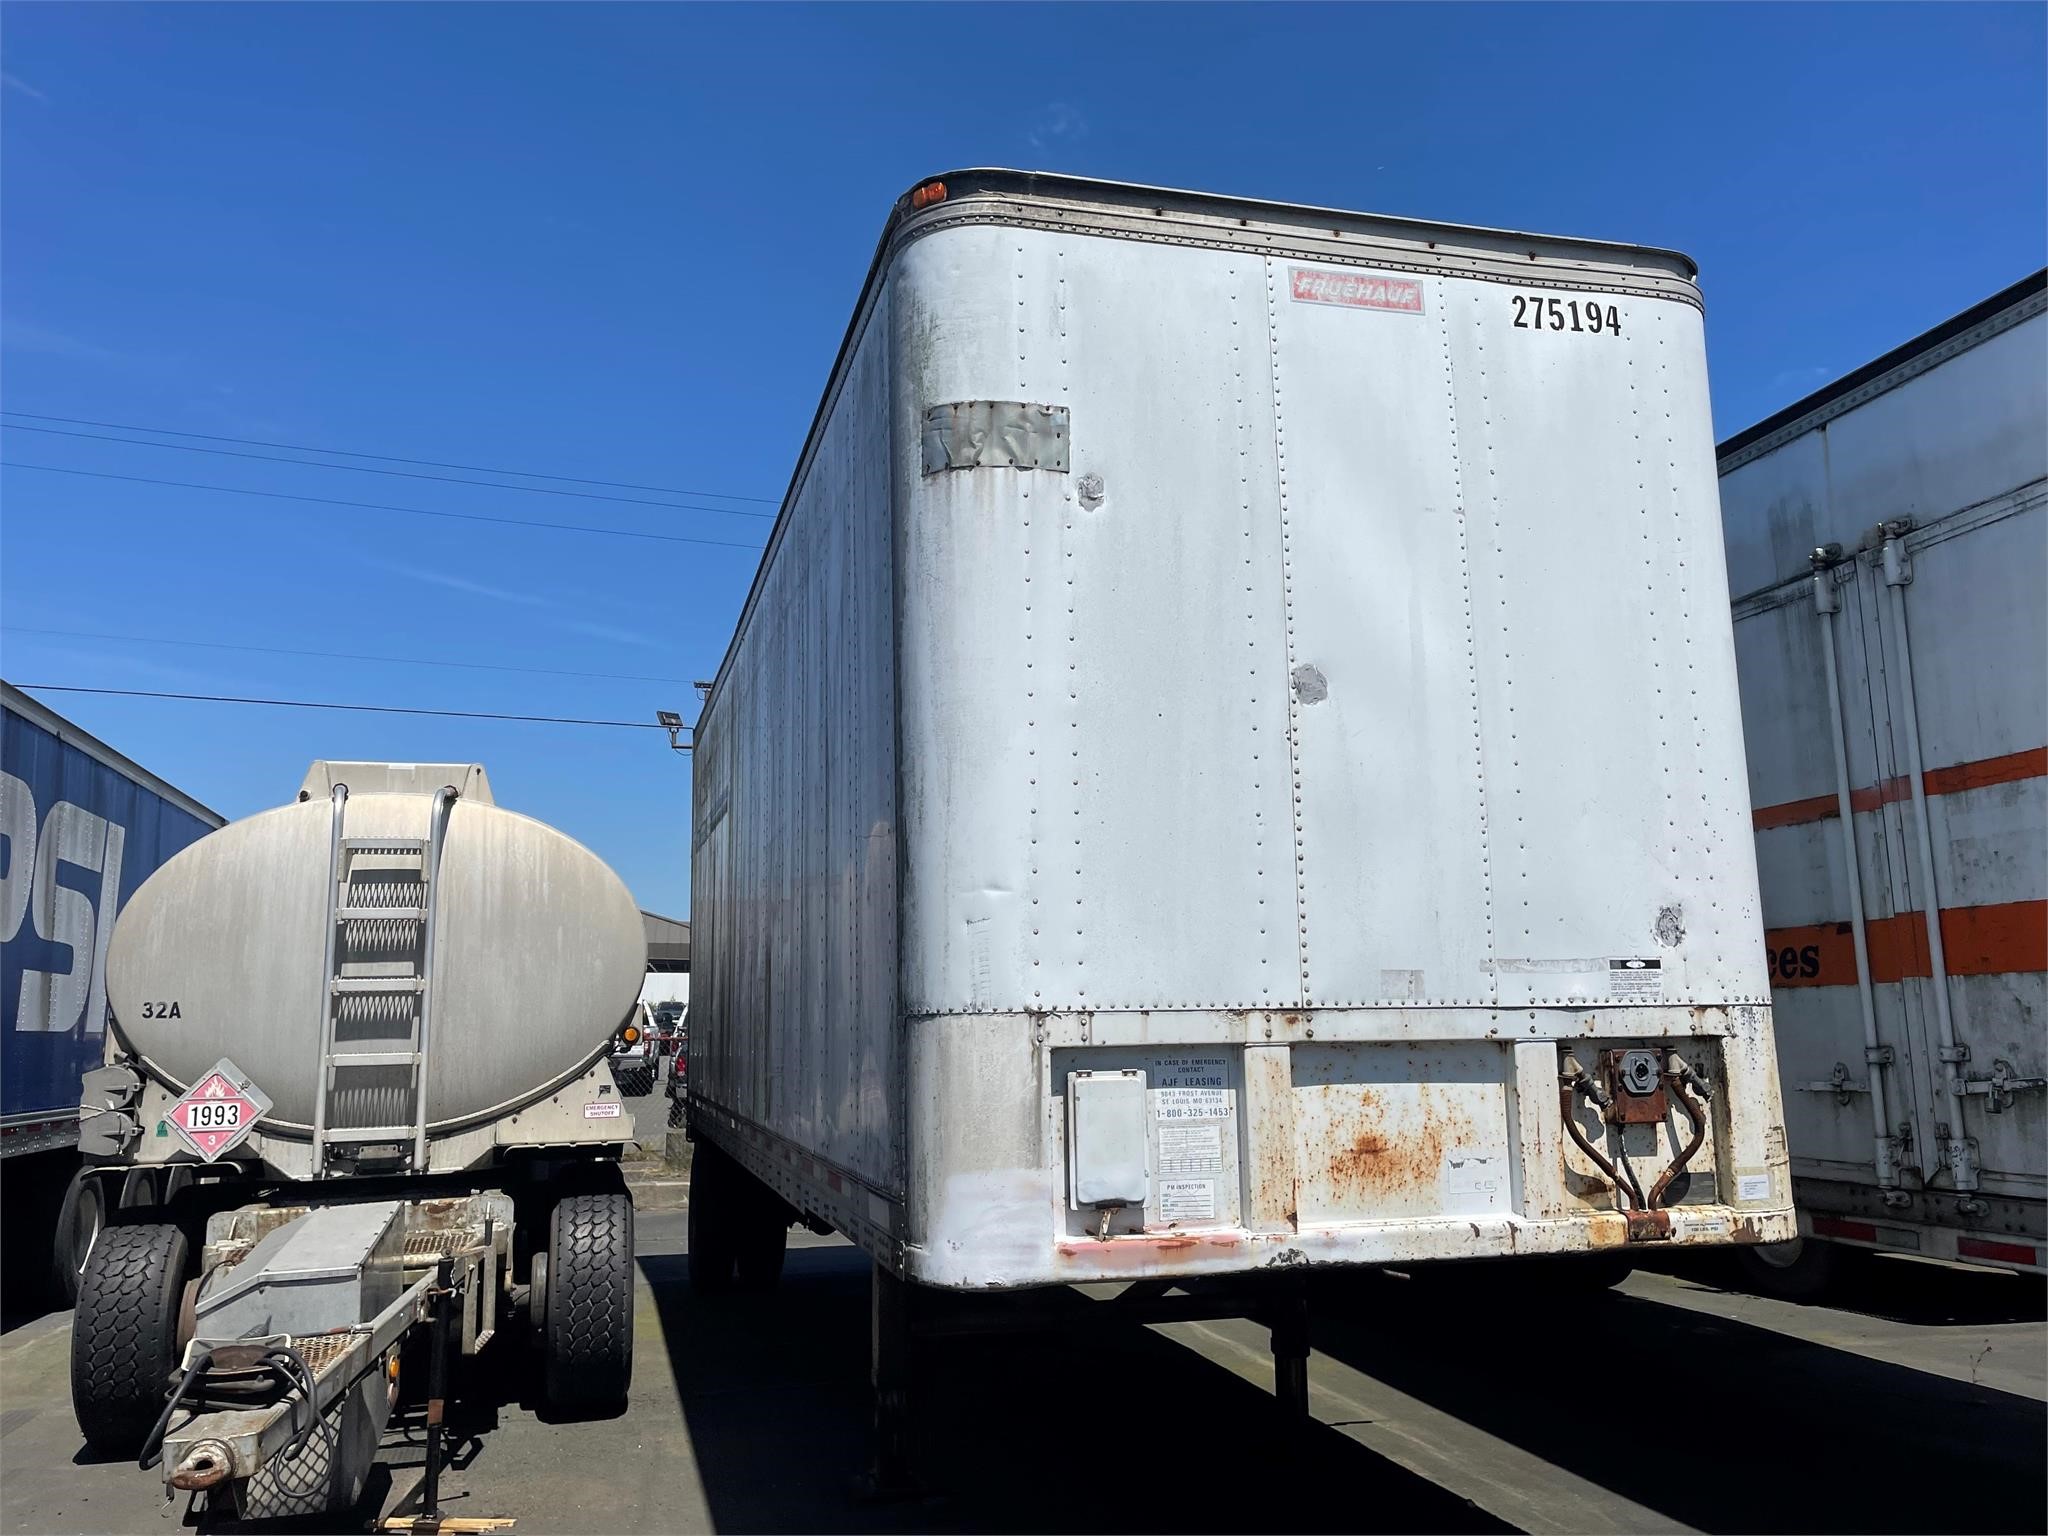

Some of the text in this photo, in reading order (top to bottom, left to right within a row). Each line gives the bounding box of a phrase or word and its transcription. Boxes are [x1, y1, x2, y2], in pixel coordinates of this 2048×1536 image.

[1300, 277, 1418, 304] FRUEHAUF
[1511, 295, 1621, 336] 275194
[142, 1001, 182, 1019] 32A
[1162, 1077, 1222, 1087] AJF LEASING
[190, 1105, 239, 1127] 1993
[207, 1135, 216, 1146] 3
